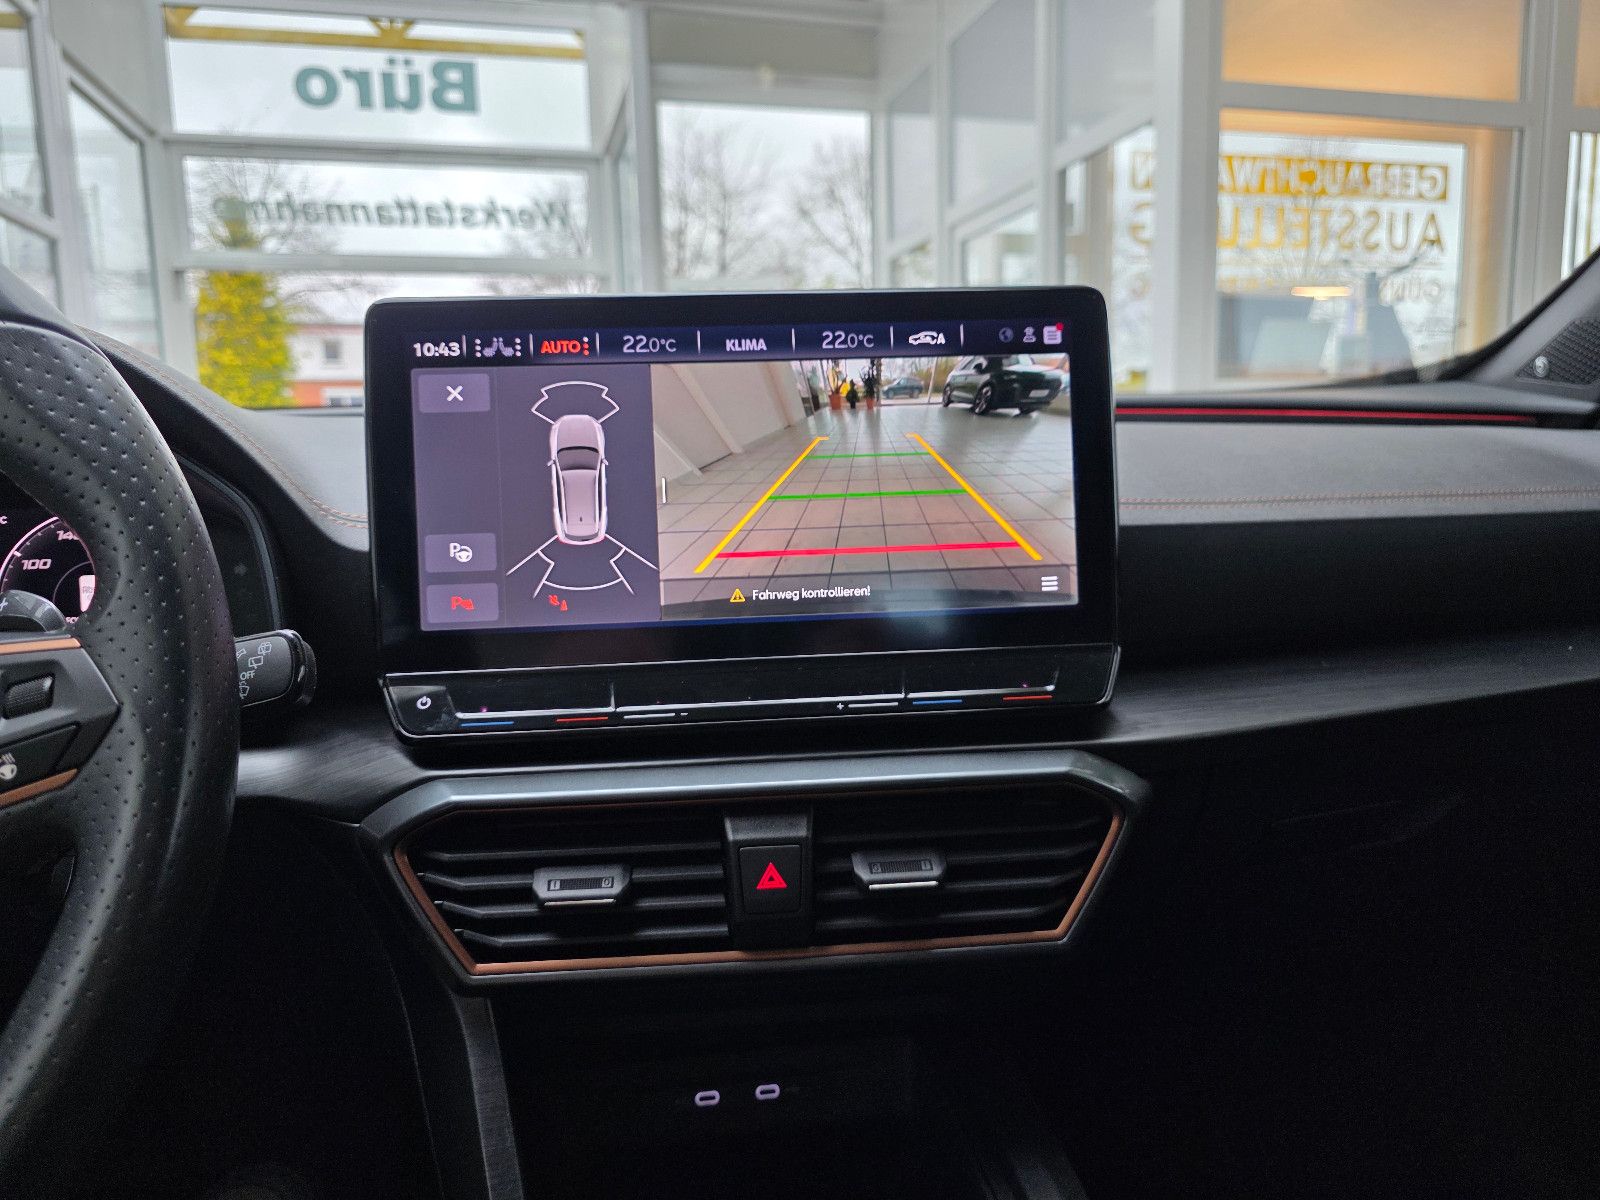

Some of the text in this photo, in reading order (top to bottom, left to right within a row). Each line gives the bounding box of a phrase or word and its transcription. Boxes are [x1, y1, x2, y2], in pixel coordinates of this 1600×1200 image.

[413, 341, 461, 358] 10:43
[540, 339, 581, 354] AUTO
[725, 337, 768, 352] KLIMA
[56, 529, 80, 541] 14
[21, 558, 52, 571] 100
[752, 585, 871, 601] Fahrweg kontrollieren!
[239, 670, 256, 681] OFF
